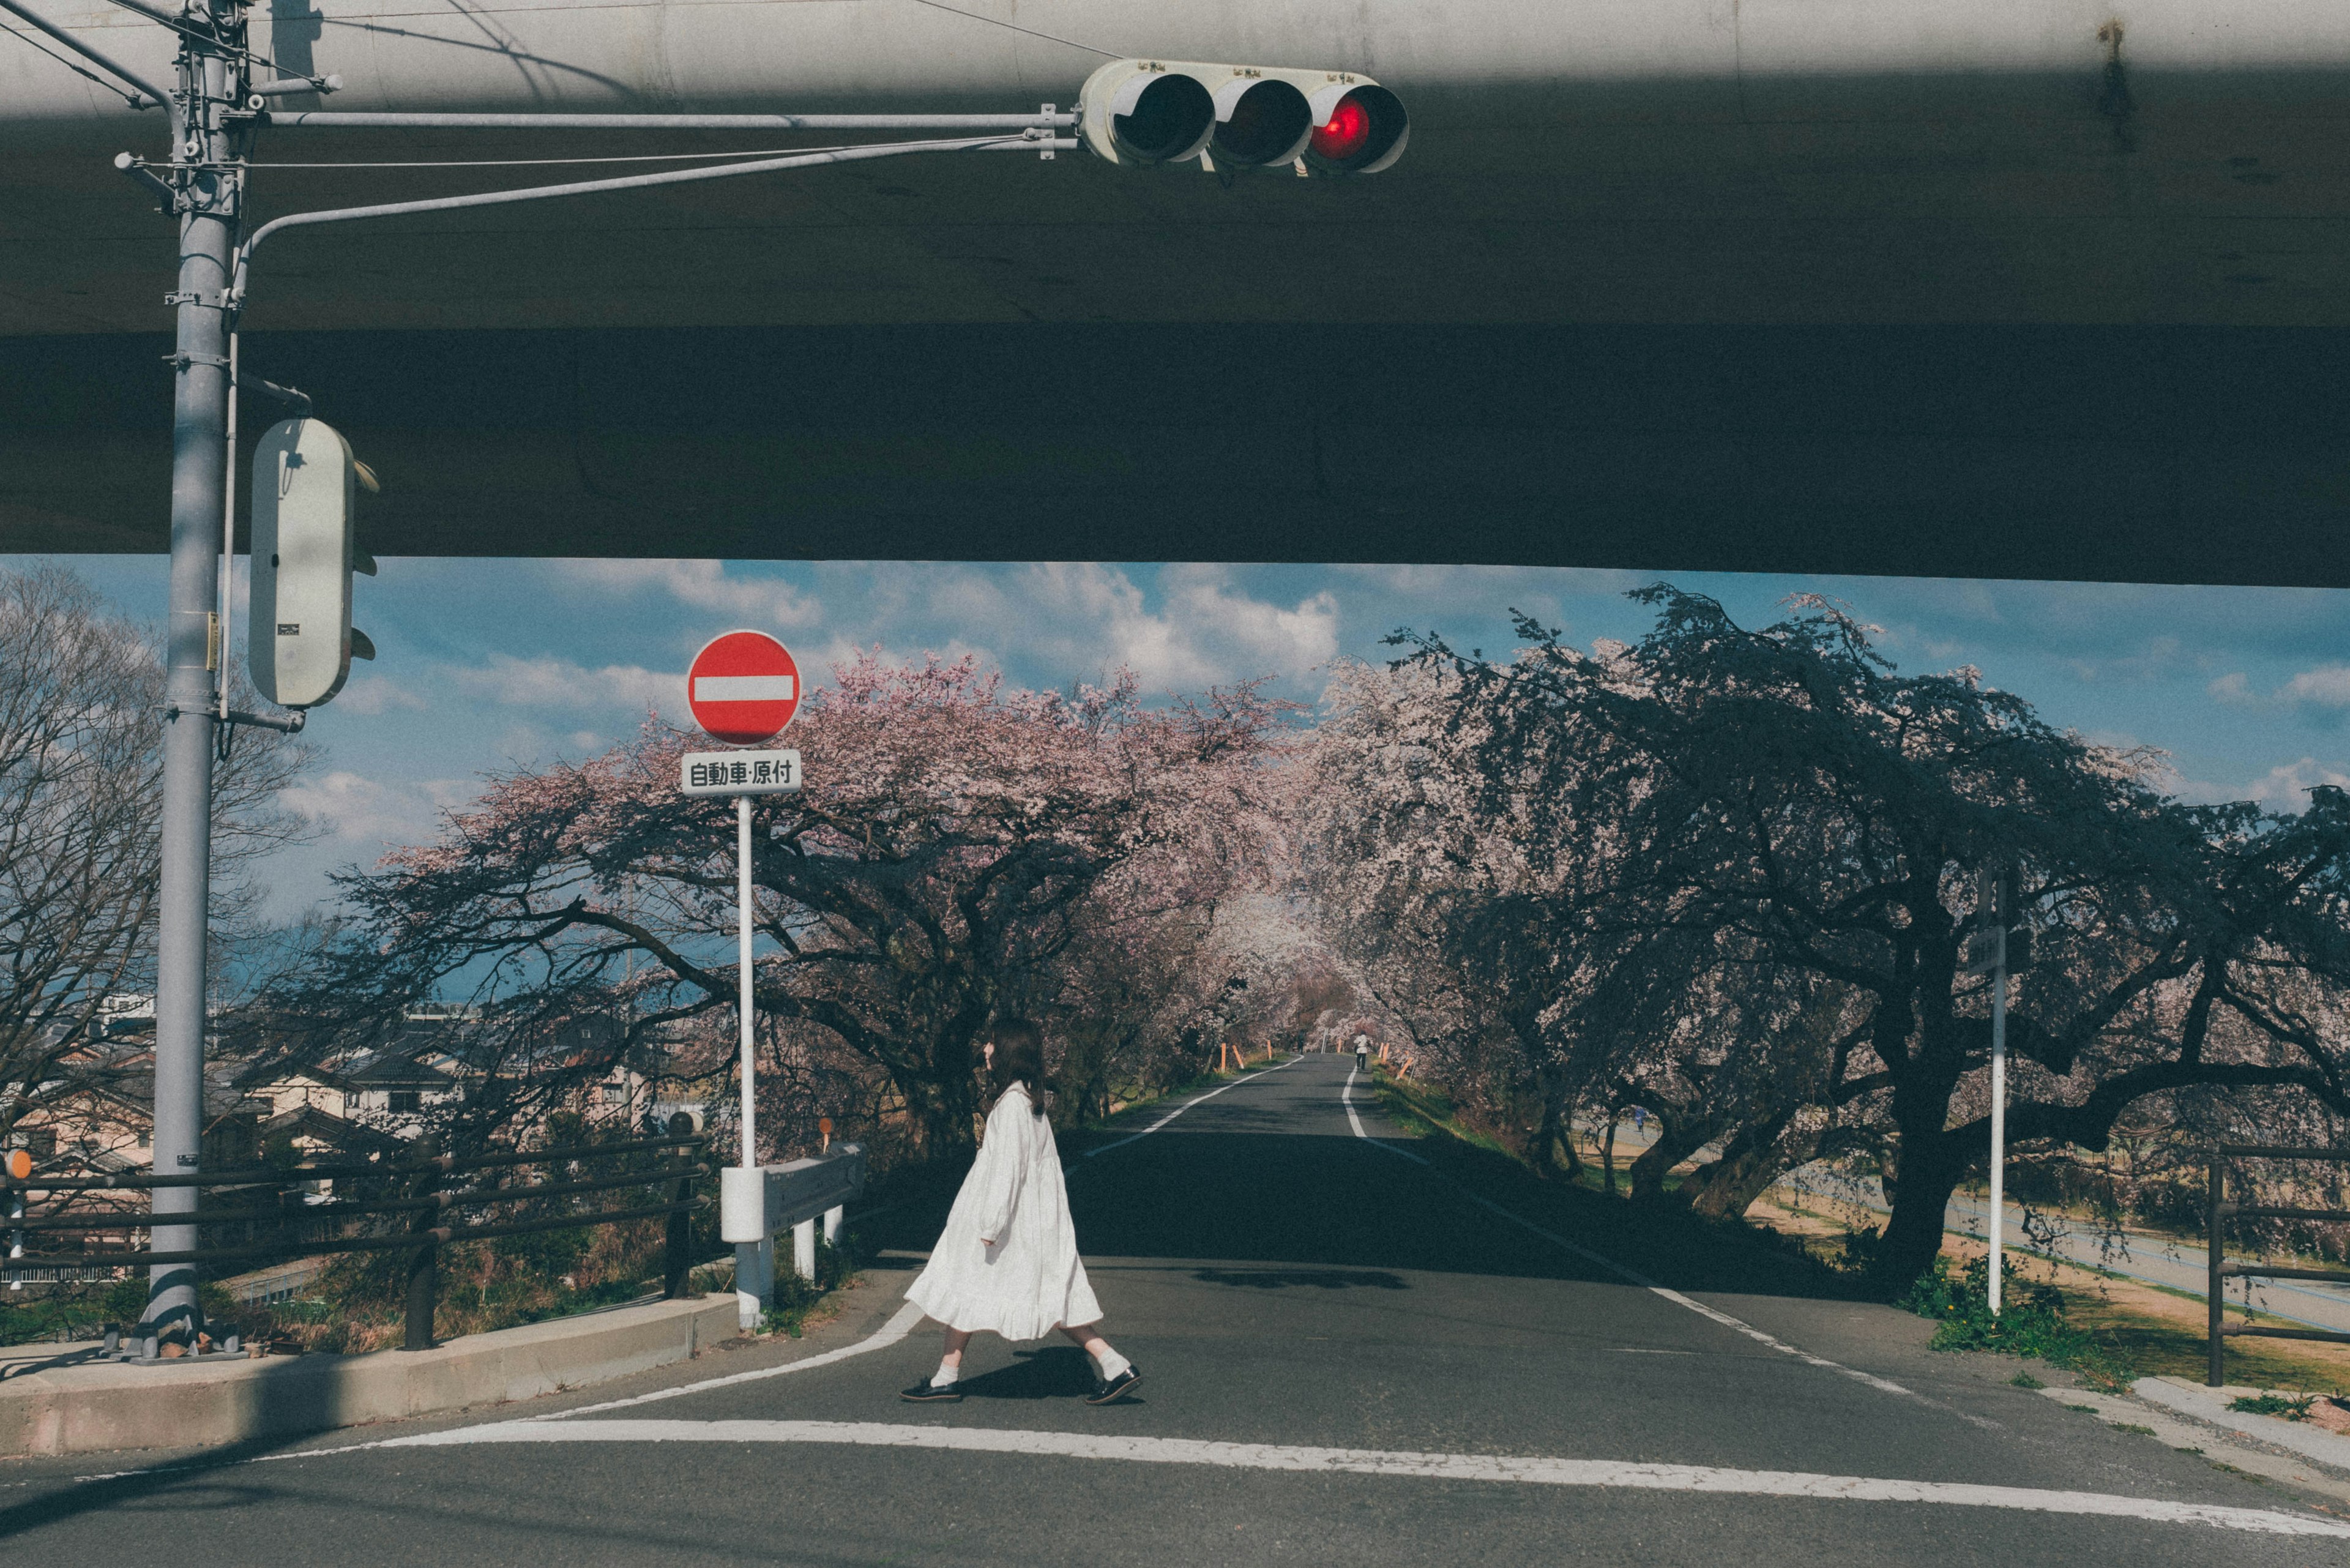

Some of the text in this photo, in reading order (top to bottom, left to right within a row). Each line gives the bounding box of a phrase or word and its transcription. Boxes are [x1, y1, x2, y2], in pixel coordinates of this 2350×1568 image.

[691, 760, 792, 786] 自動車・原付
